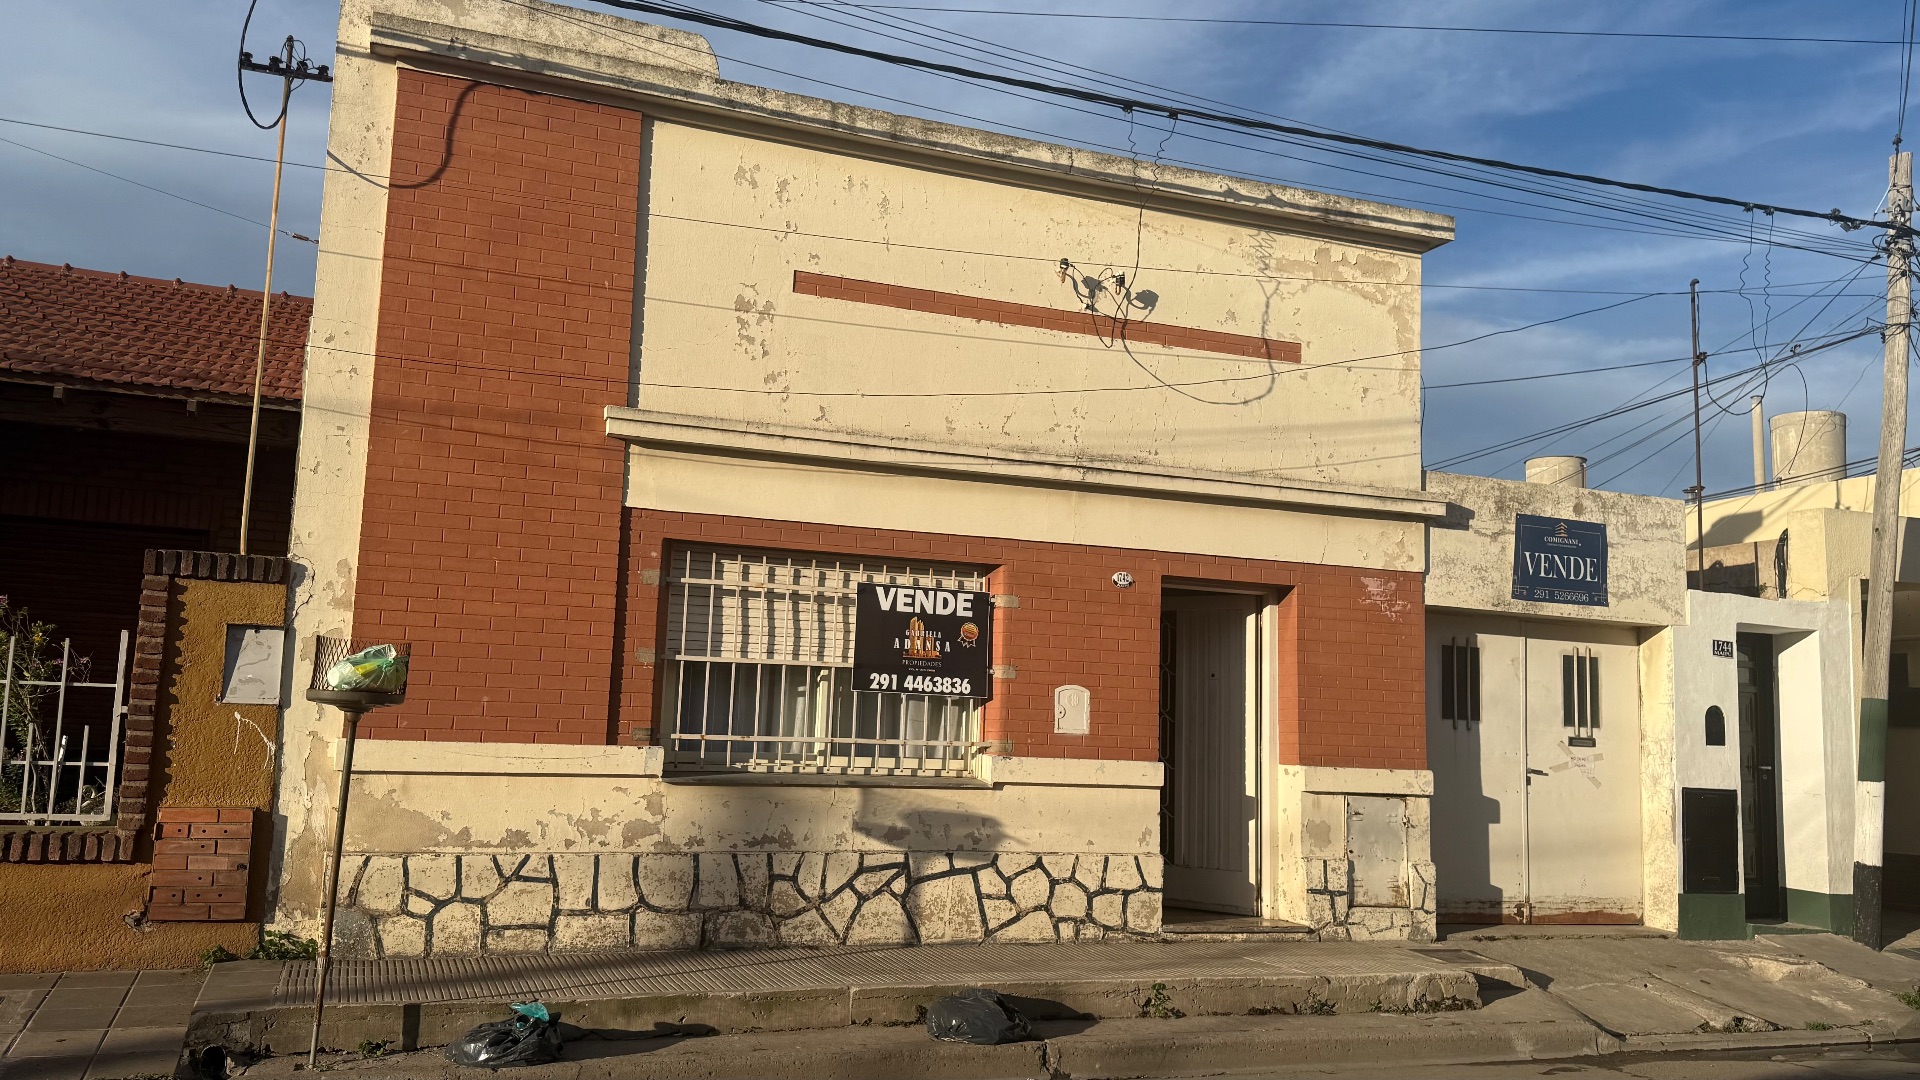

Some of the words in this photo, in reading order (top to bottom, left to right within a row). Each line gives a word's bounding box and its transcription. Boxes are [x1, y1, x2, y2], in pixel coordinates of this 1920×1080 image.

[1524, 551, 1598, 582] VENDE
[876, 586, 974, 617] VENDE
[1534, 589, 1549, 599] 291
[1554, 591, 1589, 602] 5266696
[905, 629, 942, 639] GABRIELA
[893, 637, 951, 652] ADANSA
[1714, 641, 1731, 652] 1744
[902, 659, 942, 668] PROPIEDADES
[869, 673, 898, 690] 291
[904, 675, 971, 694] 4463836
